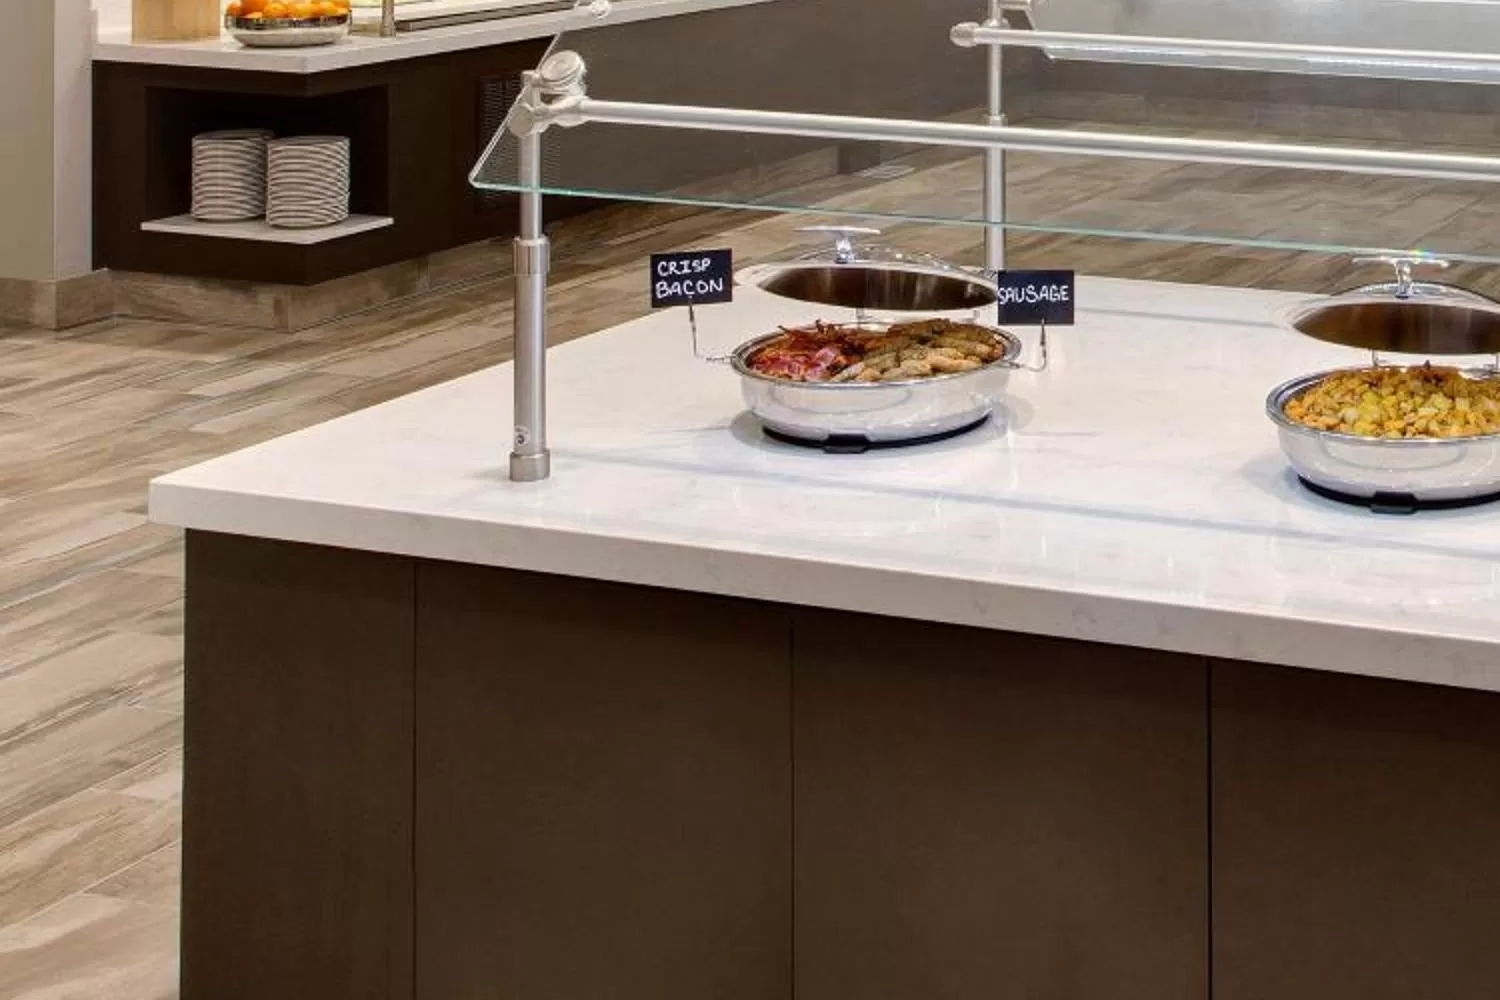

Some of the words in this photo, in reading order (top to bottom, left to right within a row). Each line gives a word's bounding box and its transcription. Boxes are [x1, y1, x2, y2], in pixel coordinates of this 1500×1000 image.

[657, 257, 711, 277] CRISP
[655, 277, 723, 299] BACON
[997, 284, 1069, 305] SAUSAGE
